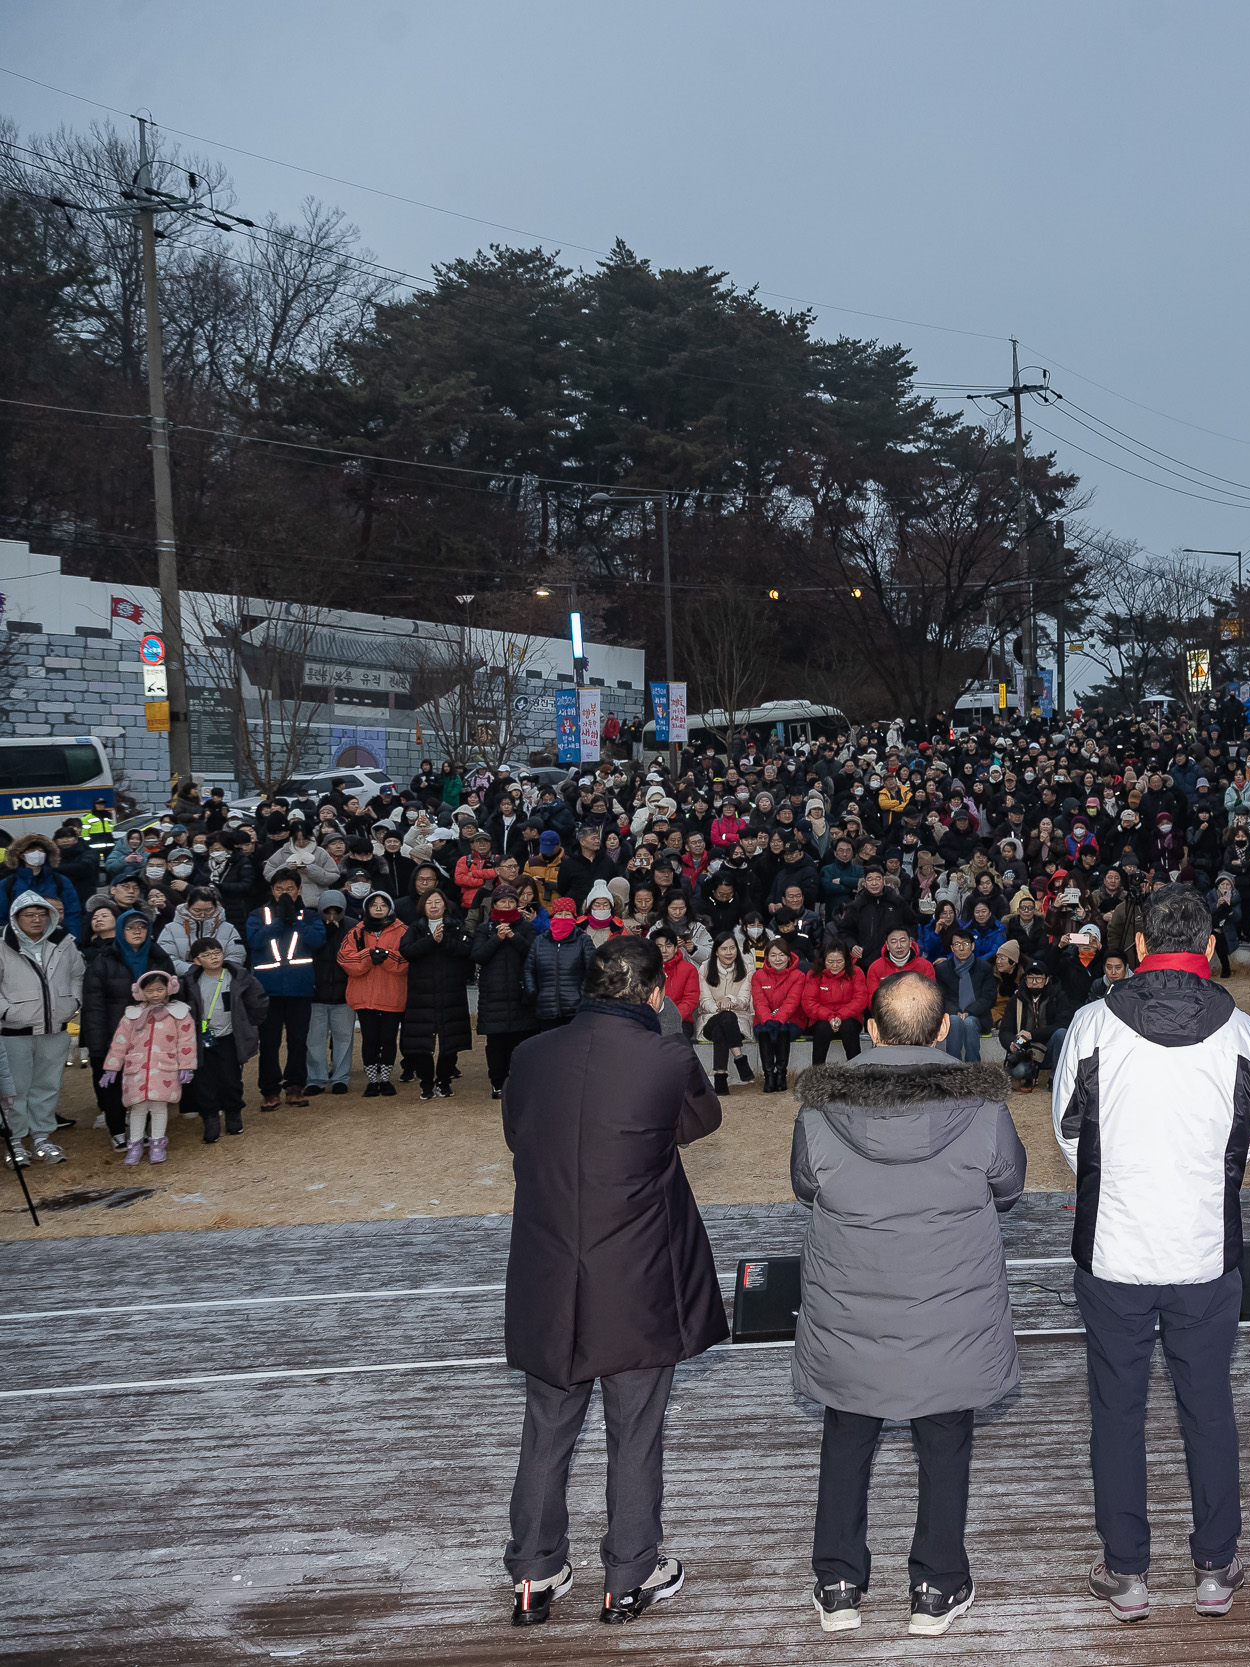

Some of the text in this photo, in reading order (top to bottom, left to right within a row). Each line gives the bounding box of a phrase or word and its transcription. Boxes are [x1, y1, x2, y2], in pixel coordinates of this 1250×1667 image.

[360, 673, 381, 687] 유적
[558, 707, 576, 716] 새해
[581, 728, 599, 739] 새해
[12, 796, 62, 811] POLICE
